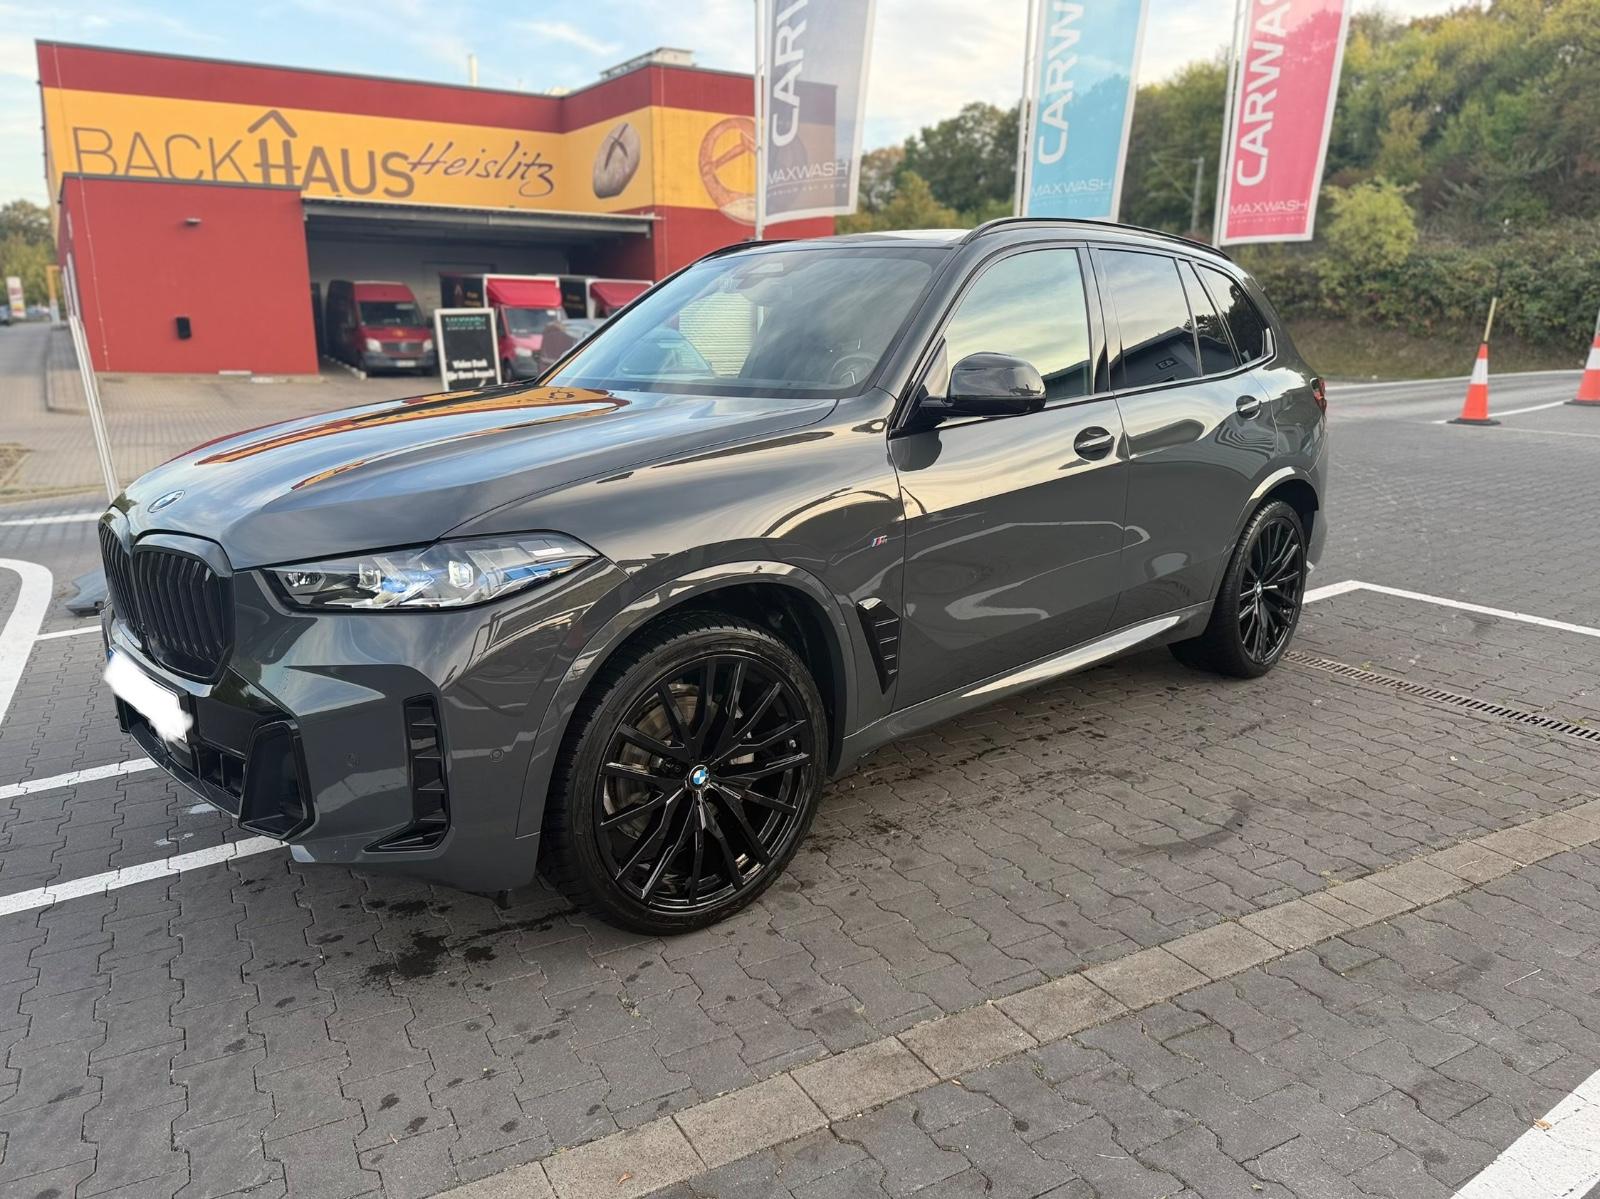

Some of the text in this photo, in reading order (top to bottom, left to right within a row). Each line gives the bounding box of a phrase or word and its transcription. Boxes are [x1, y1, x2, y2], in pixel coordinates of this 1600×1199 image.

[72, 124, 555, 198] BACKHAUS Heislitz
[767, 160, 849, 185] MAXWASH
[1032, 178, 1113, 198] MAXWASH
[1231, 199, 1309, 215] MAXWASH
